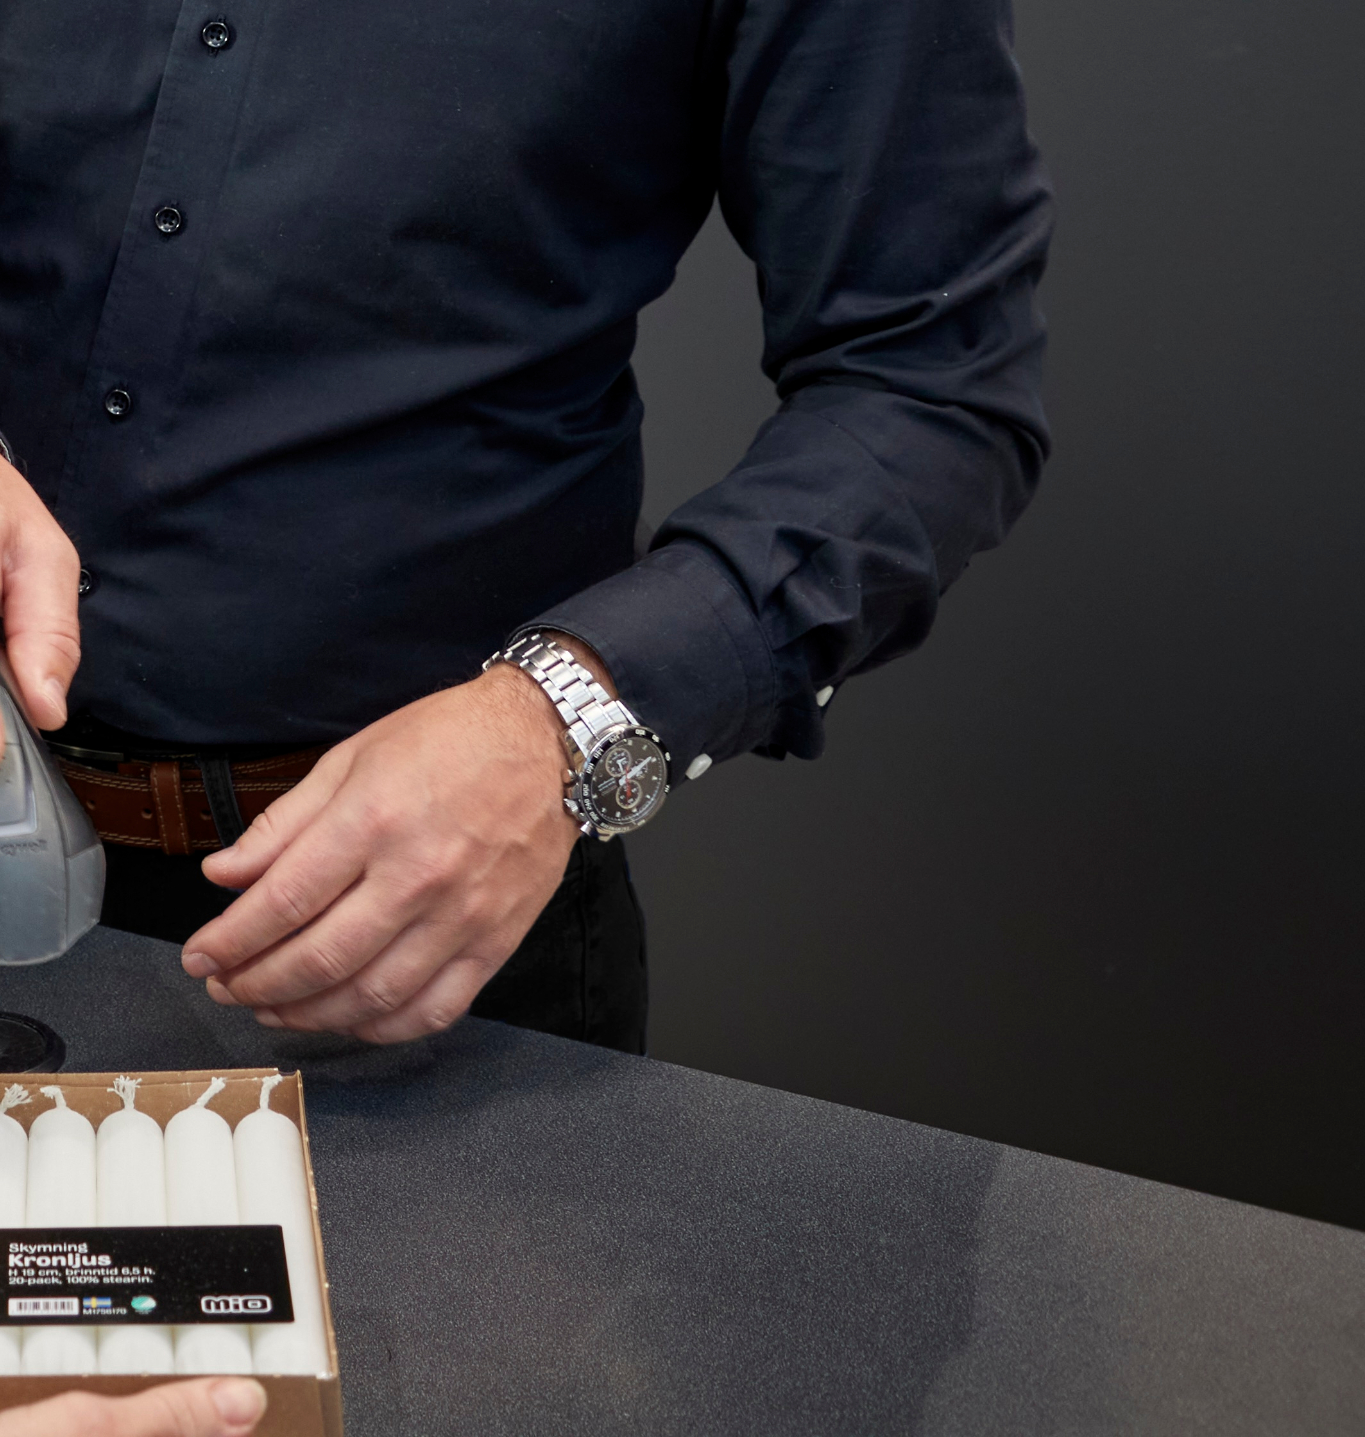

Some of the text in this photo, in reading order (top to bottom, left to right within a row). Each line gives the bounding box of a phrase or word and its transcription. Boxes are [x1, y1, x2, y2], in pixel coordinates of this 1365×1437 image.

[9, 1242, 88, 1254] Skymning
[9, 1253, 112, 1268] Kronljus
[8, 1267, 156, 1277] H 19 cm, brinntid 6,5 h.
[9, 1275, 154, 1285] 20-pack, 100% stearin.
